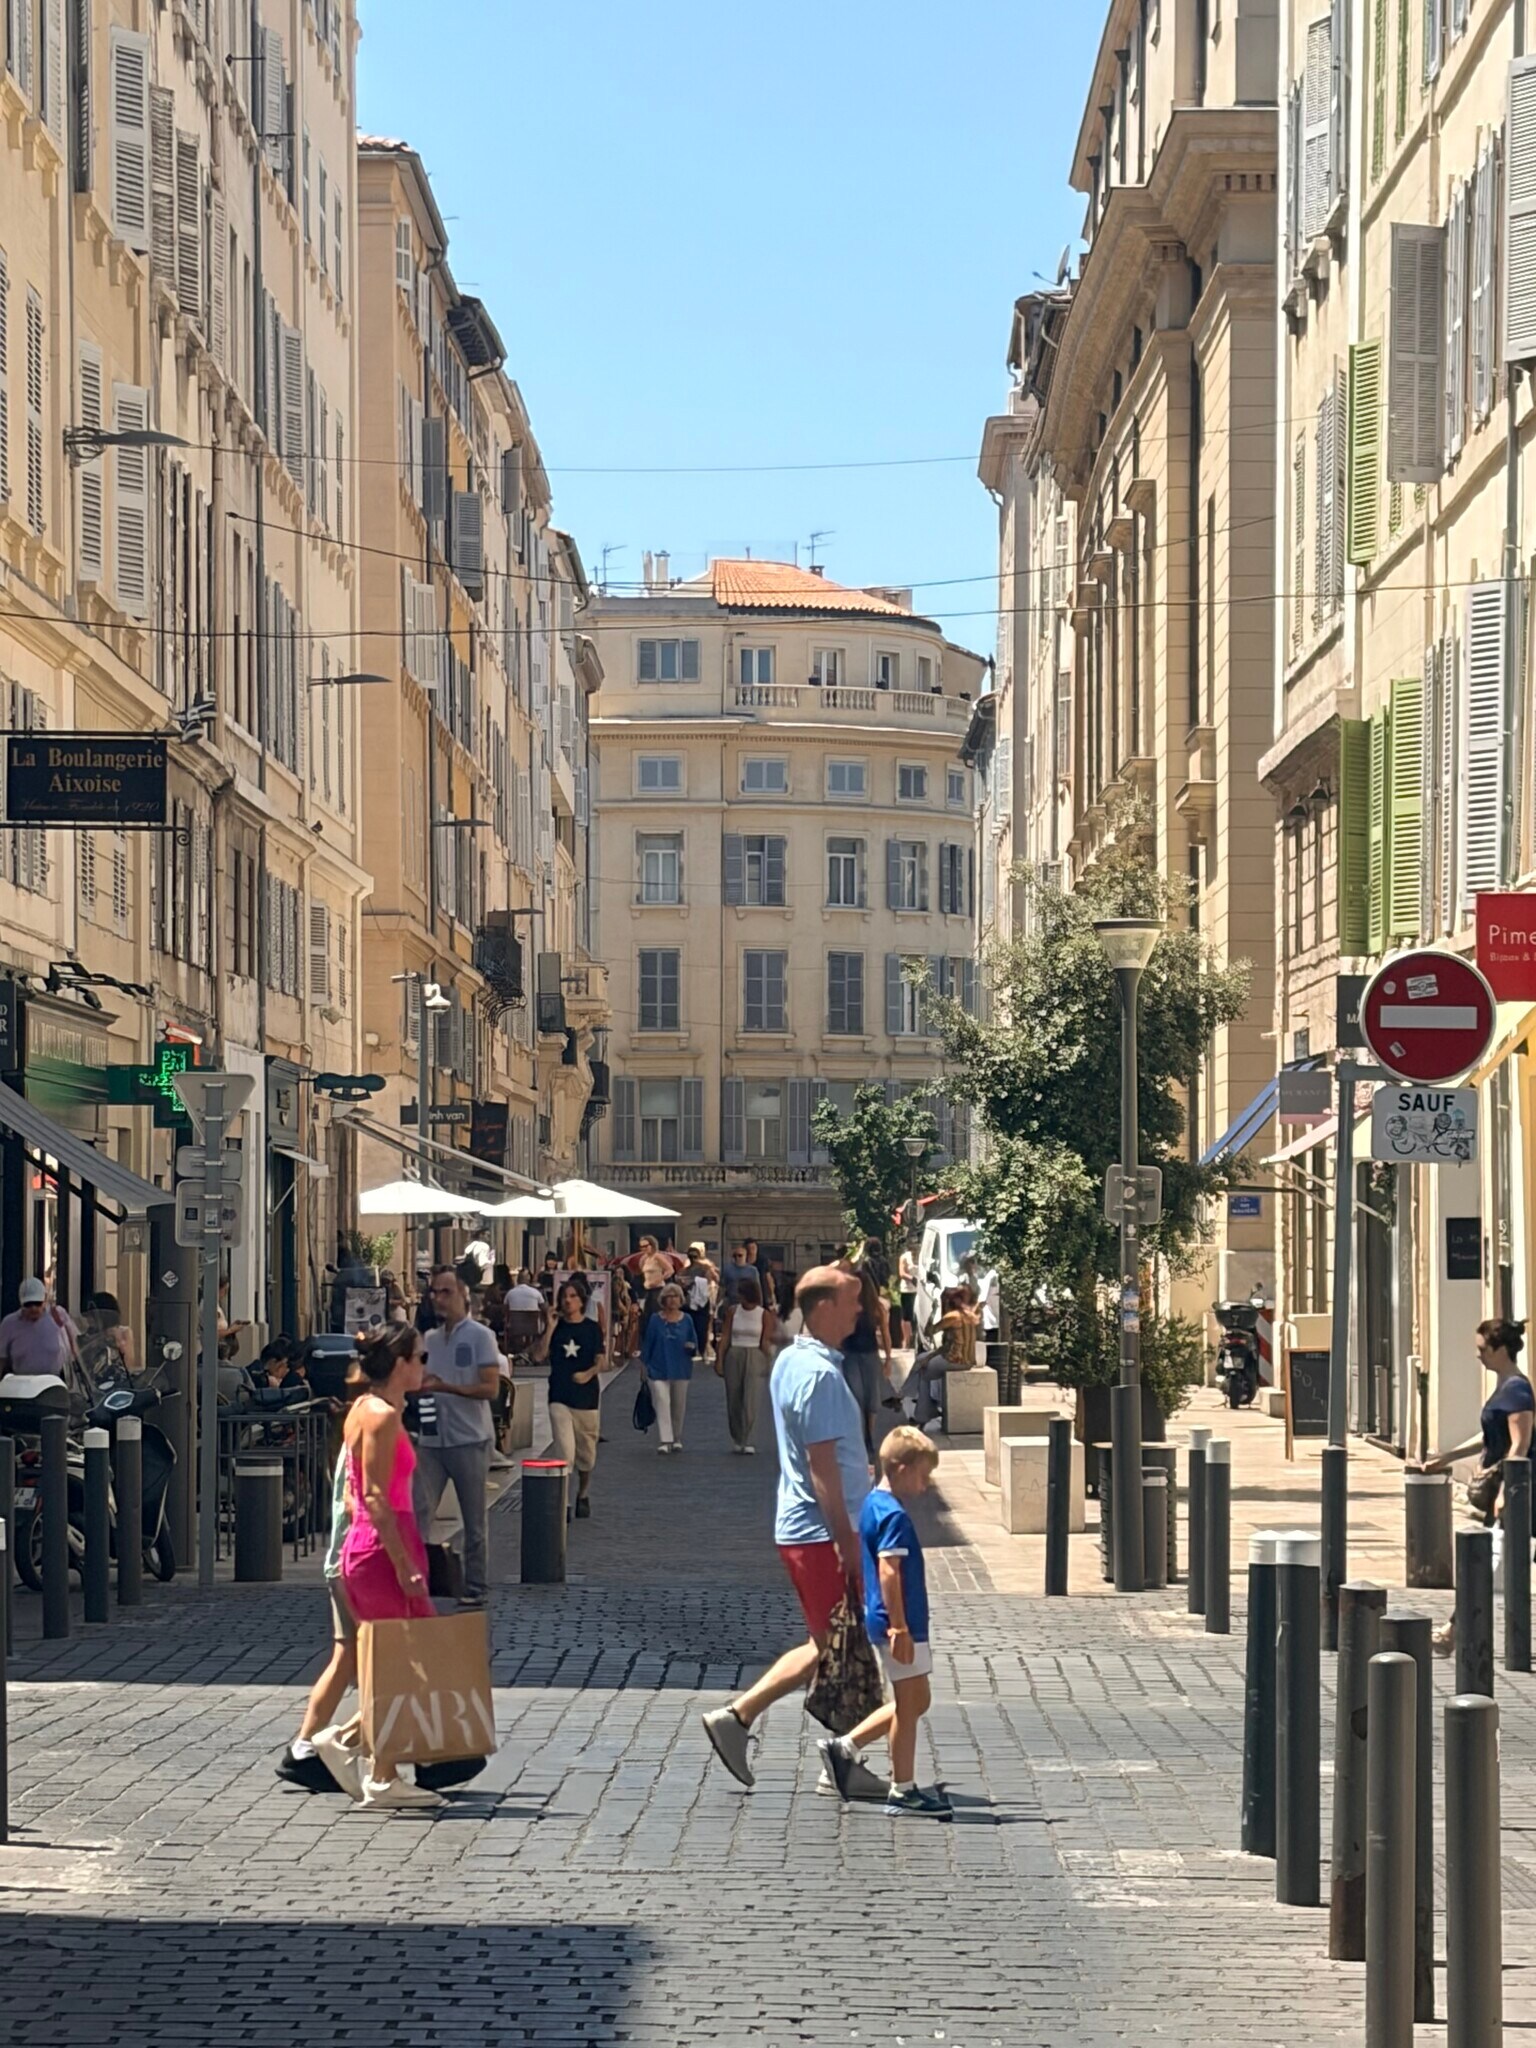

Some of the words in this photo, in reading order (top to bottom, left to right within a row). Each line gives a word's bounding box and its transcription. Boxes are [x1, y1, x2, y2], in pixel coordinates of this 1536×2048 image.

[12, 747, 36, 767] La
[48, 747, 164, 772] Boulangerie
[48, 774, 122, 793] Aixoise
[1489, 924, 1536, 946] Pime
[1398, 1093, 1455, 1112] SAUF
[446, 1112, 465, 1120] van
